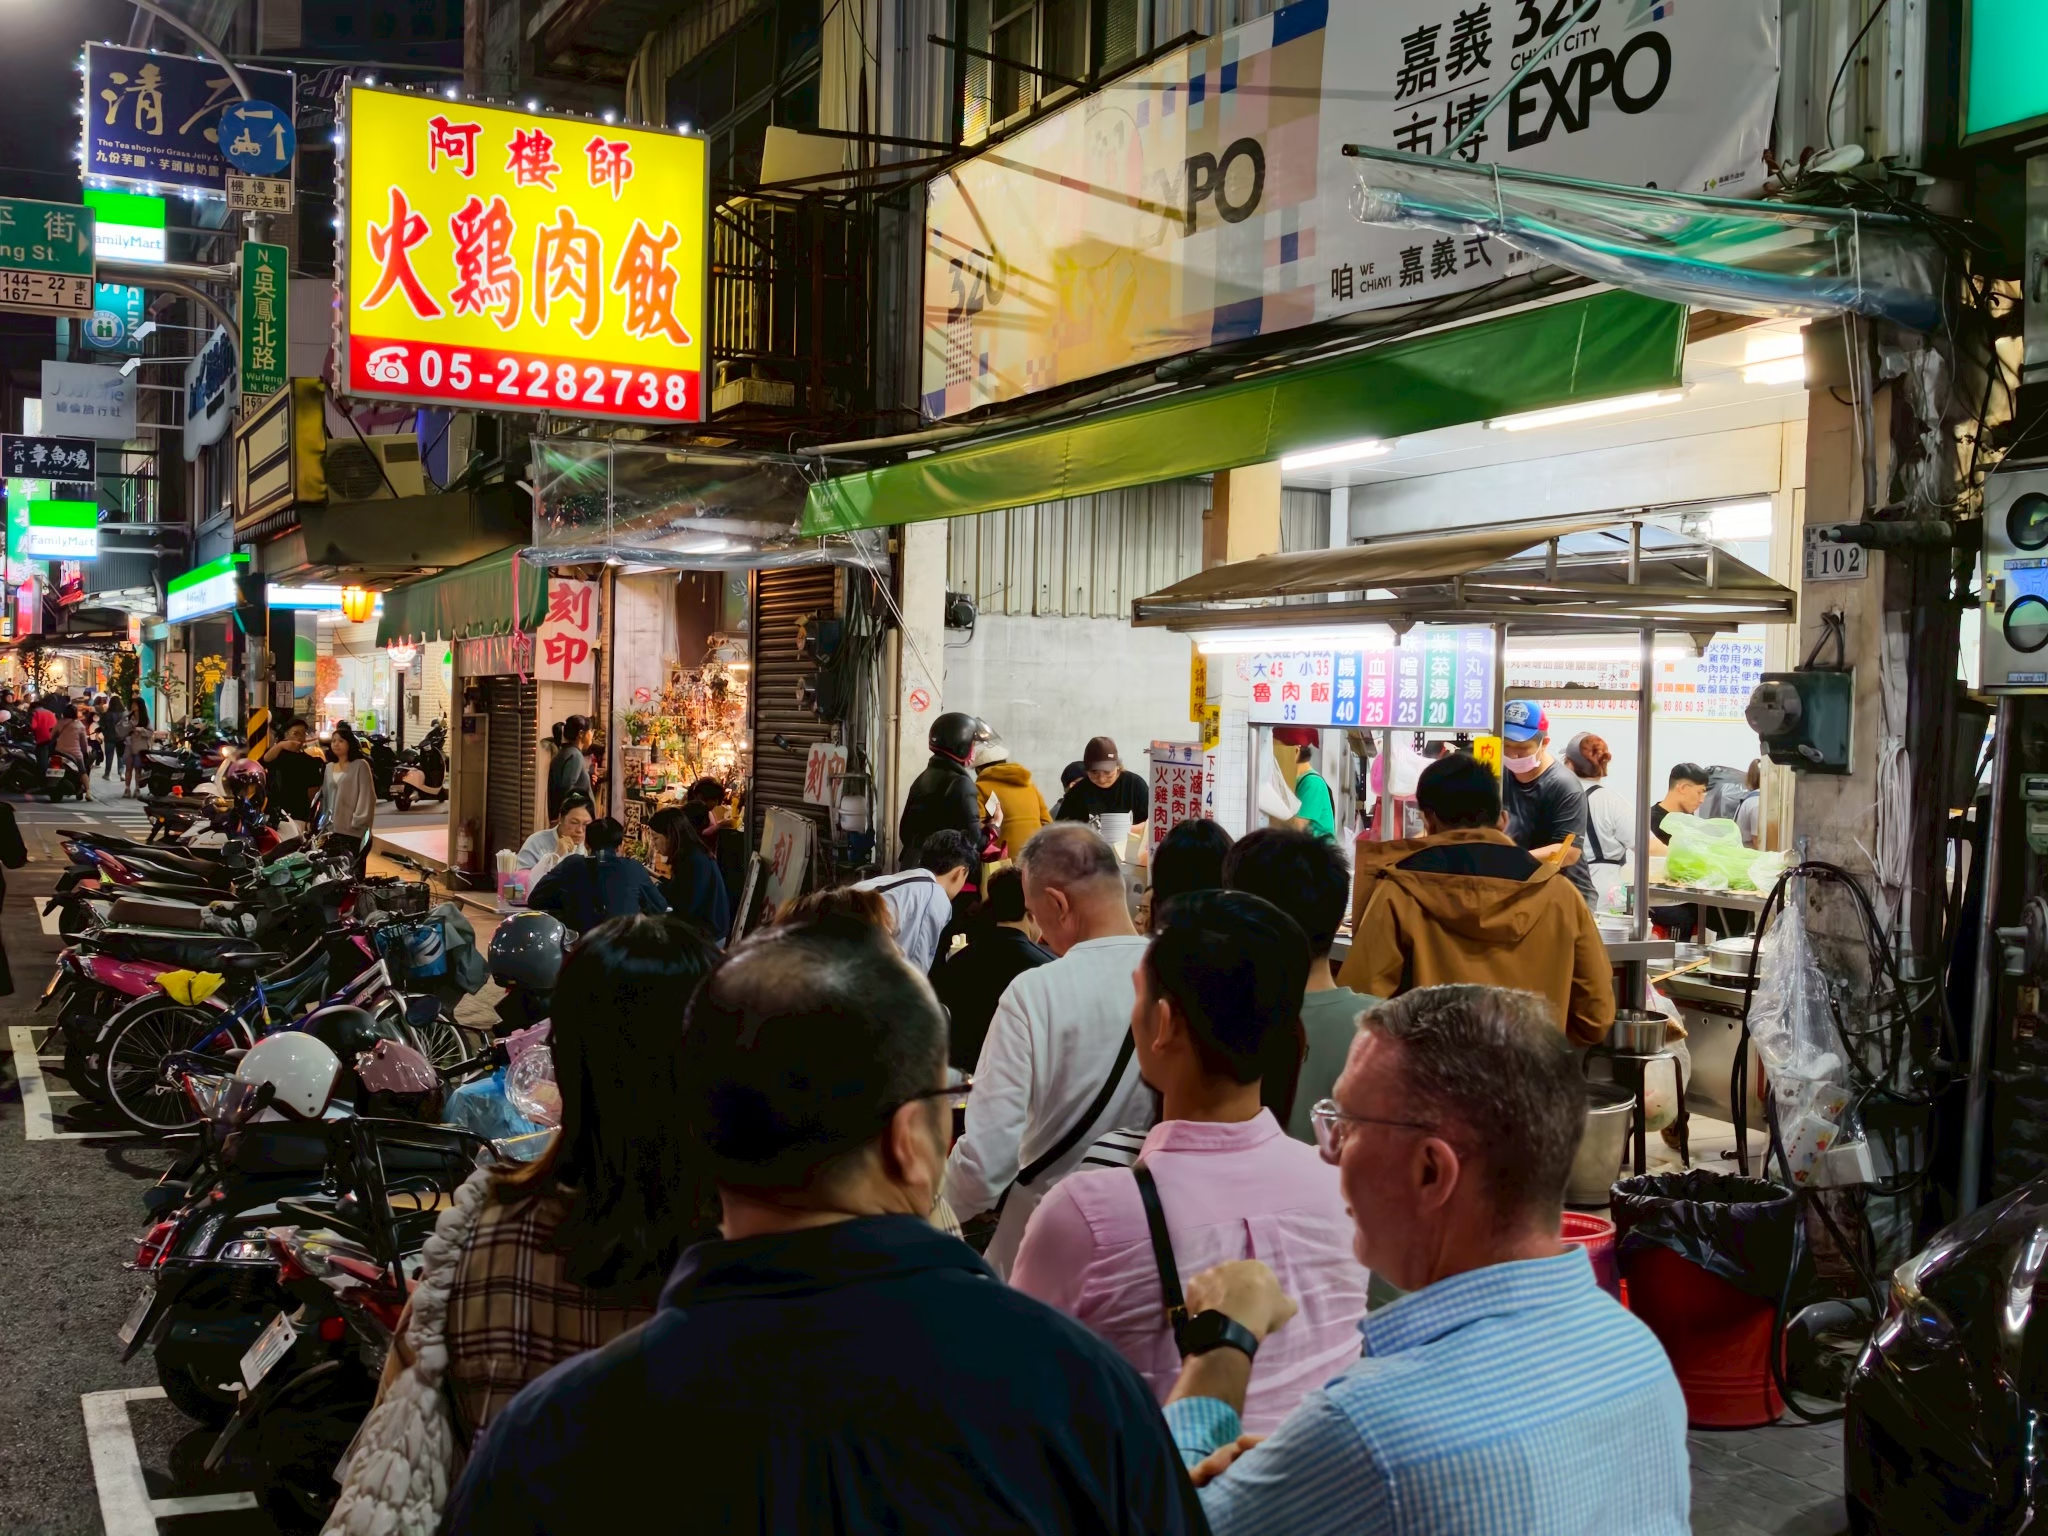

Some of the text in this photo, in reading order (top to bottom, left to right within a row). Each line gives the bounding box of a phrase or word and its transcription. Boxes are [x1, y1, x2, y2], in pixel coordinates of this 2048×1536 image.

[1394, 2, 1493, 101] 嘉義
[1508, 31, 1672, 152] EXPO
[1393, 93, 1489, 163] 市博
[97, 138, 113, 148] The
[114, 140, 129, 150] Tea
[131, 142, 151, 153] shop
[153, 146, 165, 154] for
[166, 148, 190, 158] Grass
[427, 113, 635, 201] 阿樓師
[231, 179, 286, 195] 機慢車
[231, 194, 287, 209] 兩段左轉
[95, 235, 162, 249] amilyMart
[1360, 262, 1375, 277] WE
[1399, 234, 1492, 288] 嘉義式
[75, 280, 87, 292] 東
[948, 250, 1007, 325] 320
[1331, 262, 1354, 302] 咱
[127, 287, 139, 349] CLINC
[252, 272, 277, 371] 吳鳳北路
[246, 372, 283, 385] Wufeng
[419, 349, 687, 411] 05-2282738
[13, 440, 25, 474] 二代目
[29, 443, 90, 470] 章魚燒
[30, 534, 95, 547] FamilyMart
[1820, 547, 1860, 574] 102
[543, 582, 592, 681] 刻印
[1253, 663, 1268, 677] 大
[1270, 661, 1283, 678] 45
[1299, 661, 1313, 676] 小
[1316, 659, 1329, 676] 35
[1338, 649, 1356, 699] 腸湯
[1367, 650, 1386, 699] 血湯
[1253, 682, 1330, 703] 魯肉飯
[1284, 704, 1296, 720] 35
[1336, 701, 1482, 724] 40 25 25 20 25
[1154, 766, 1169, 843] 火雞肉飯
